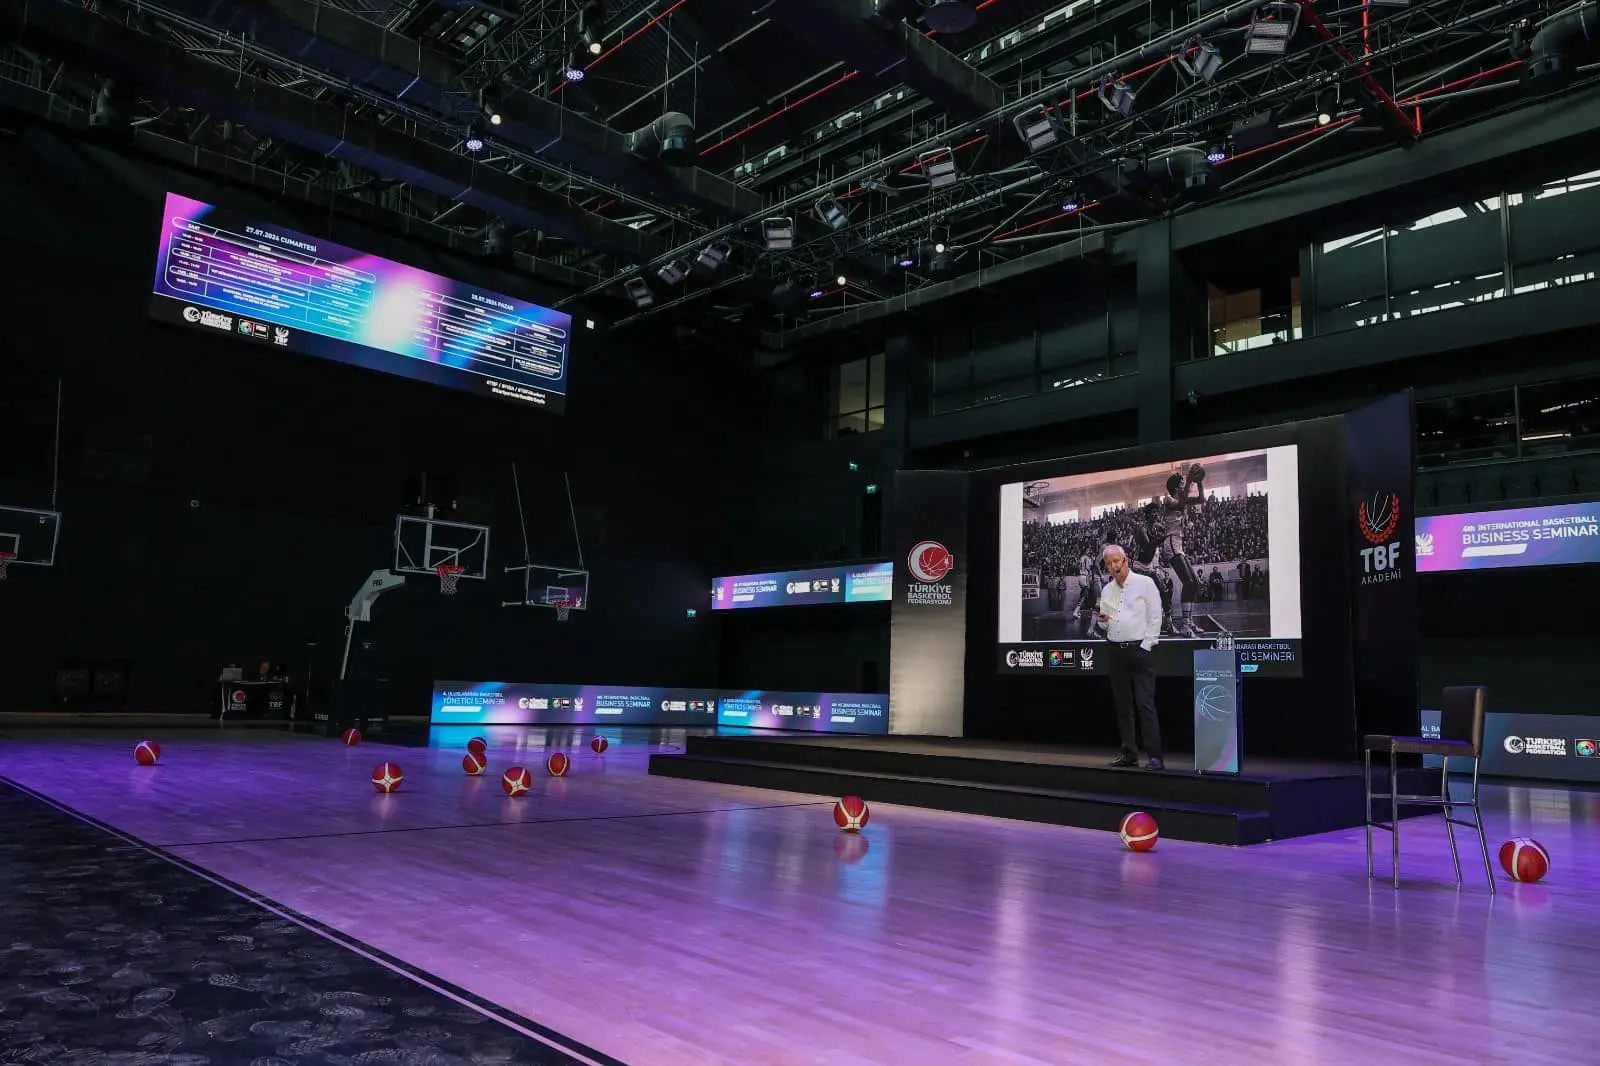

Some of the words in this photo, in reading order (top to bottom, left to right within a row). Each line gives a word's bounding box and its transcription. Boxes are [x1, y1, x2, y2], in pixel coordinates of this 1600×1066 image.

[245, 226, 280, 241] 27.07.2024
[280, 236, 317, 253] CUMARTESİ
[1478, 520, 1541, 531] INTERNATIONAL
[1543, 516, 1597, 526] BASKETBALL
[1462, 530, 1530, 545] BUSINESS
[1532, 525, 1599, 540] SEMINAR
[1360, 541, 1400, 573] TBF
[1361, 568, 1401, 585] AKADEMİ
[908, 582, 952, 594] TÜRKİYE
[596, 699, 625, 707] BUSINESS
[625, 700, 651, 708] SEMINAR
[831, 707, 857, 716] BUSINESS
[857, 709, 882, 717] SEMINAR
[1525, 737, 1566, 746] TURKISH
